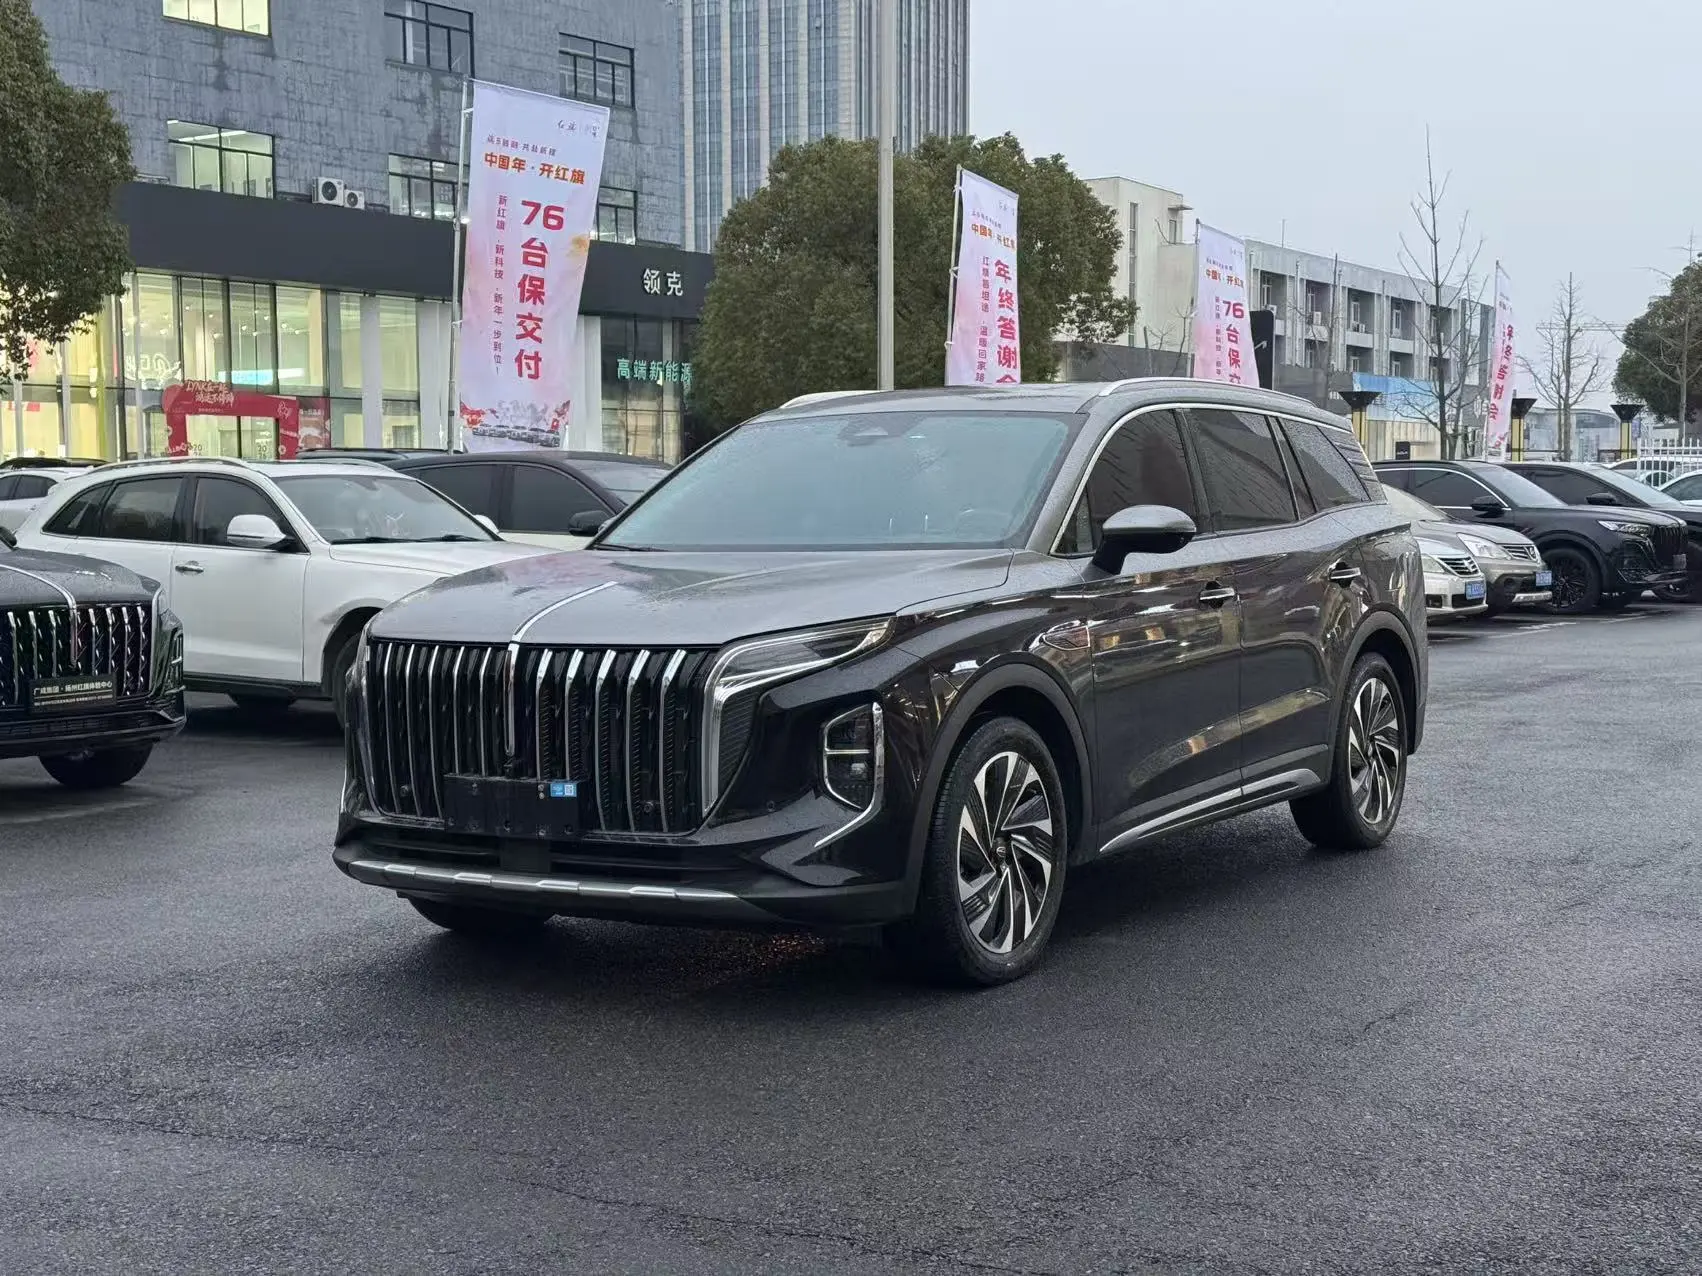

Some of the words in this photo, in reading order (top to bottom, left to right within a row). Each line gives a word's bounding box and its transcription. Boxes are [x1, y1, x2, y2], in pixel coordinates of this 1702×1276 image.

[484, 151, 586, 185] 中国年·开红旗
[643, 268, 683, 296] 领克
[617, 358, 692, 383] 高端新能源
